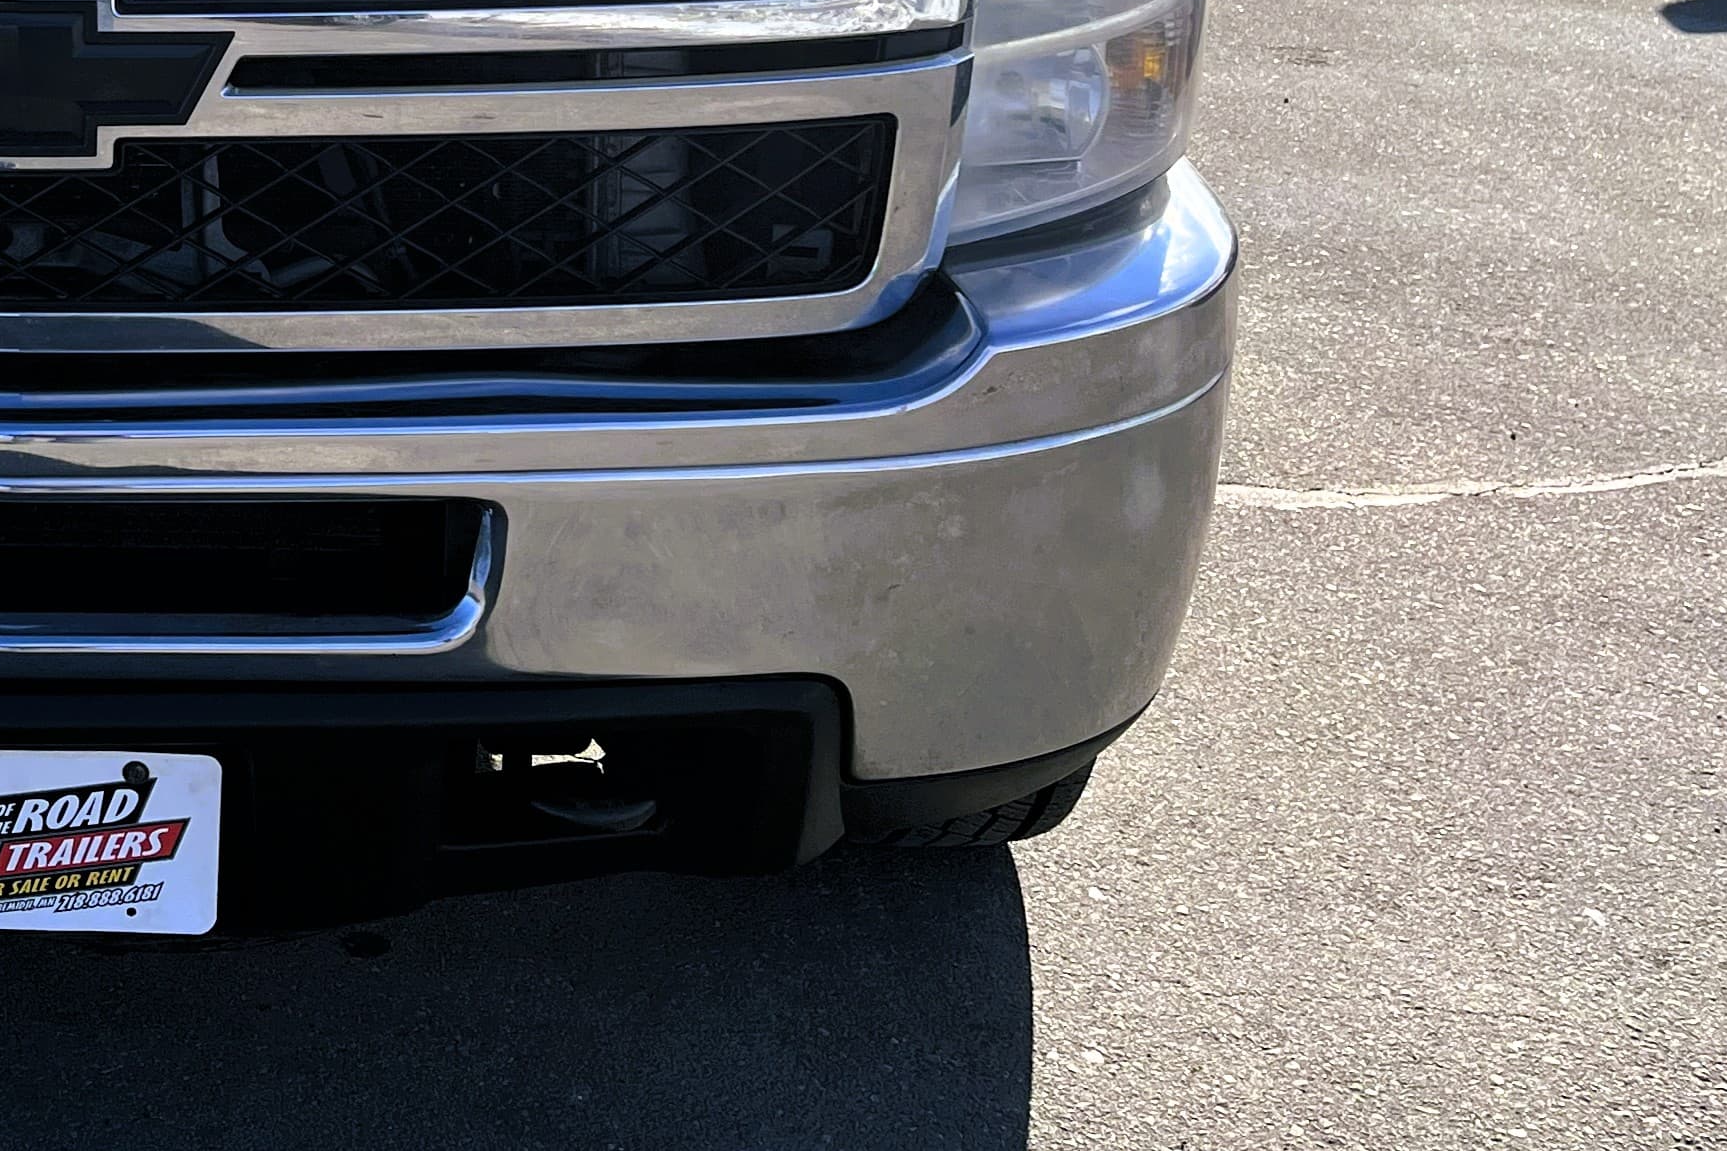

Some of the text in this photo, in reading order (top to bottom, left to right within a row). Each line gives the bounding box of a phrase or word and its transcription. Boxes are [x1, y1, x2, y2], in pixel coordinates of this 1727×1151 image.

[11, 788, 140, 834] ROAD
[5, 827, 170, 872] TRAILERS
[8, 876, 50, 896] SALE
[54, 873, 82, 890] OR
[85, 866, 135, 887] RENT
[37, 896, 58, 910] MN
[56, 884, 163, 913] 218.888.6181
